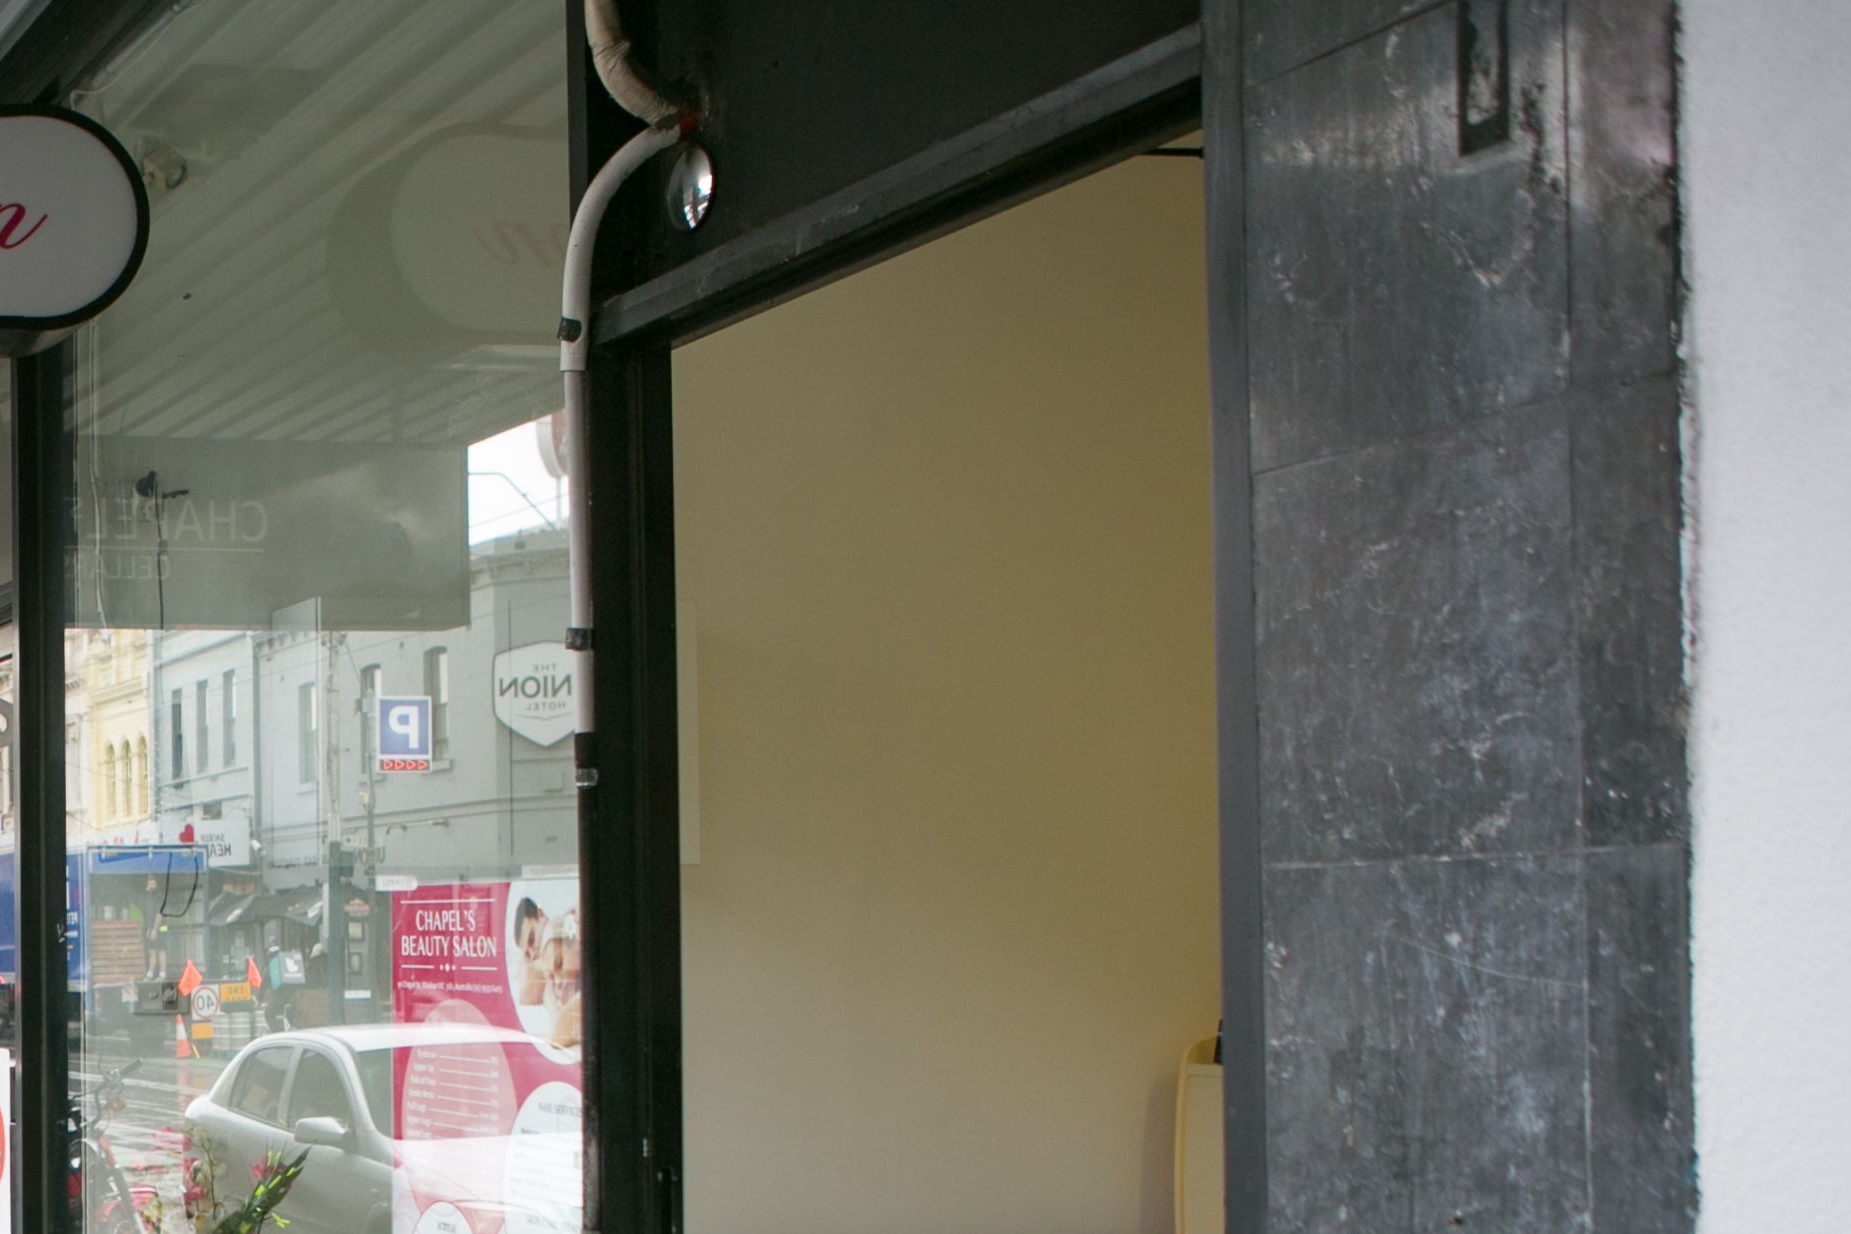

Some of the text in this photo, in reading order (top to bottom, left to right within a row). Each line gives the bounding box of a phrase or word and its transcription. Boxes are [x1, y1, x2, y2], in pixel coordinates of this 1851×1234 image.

[415, 910, 476, 931] CHAPEL'S
[401, 935, 497, 957] BEAUTY SALON
